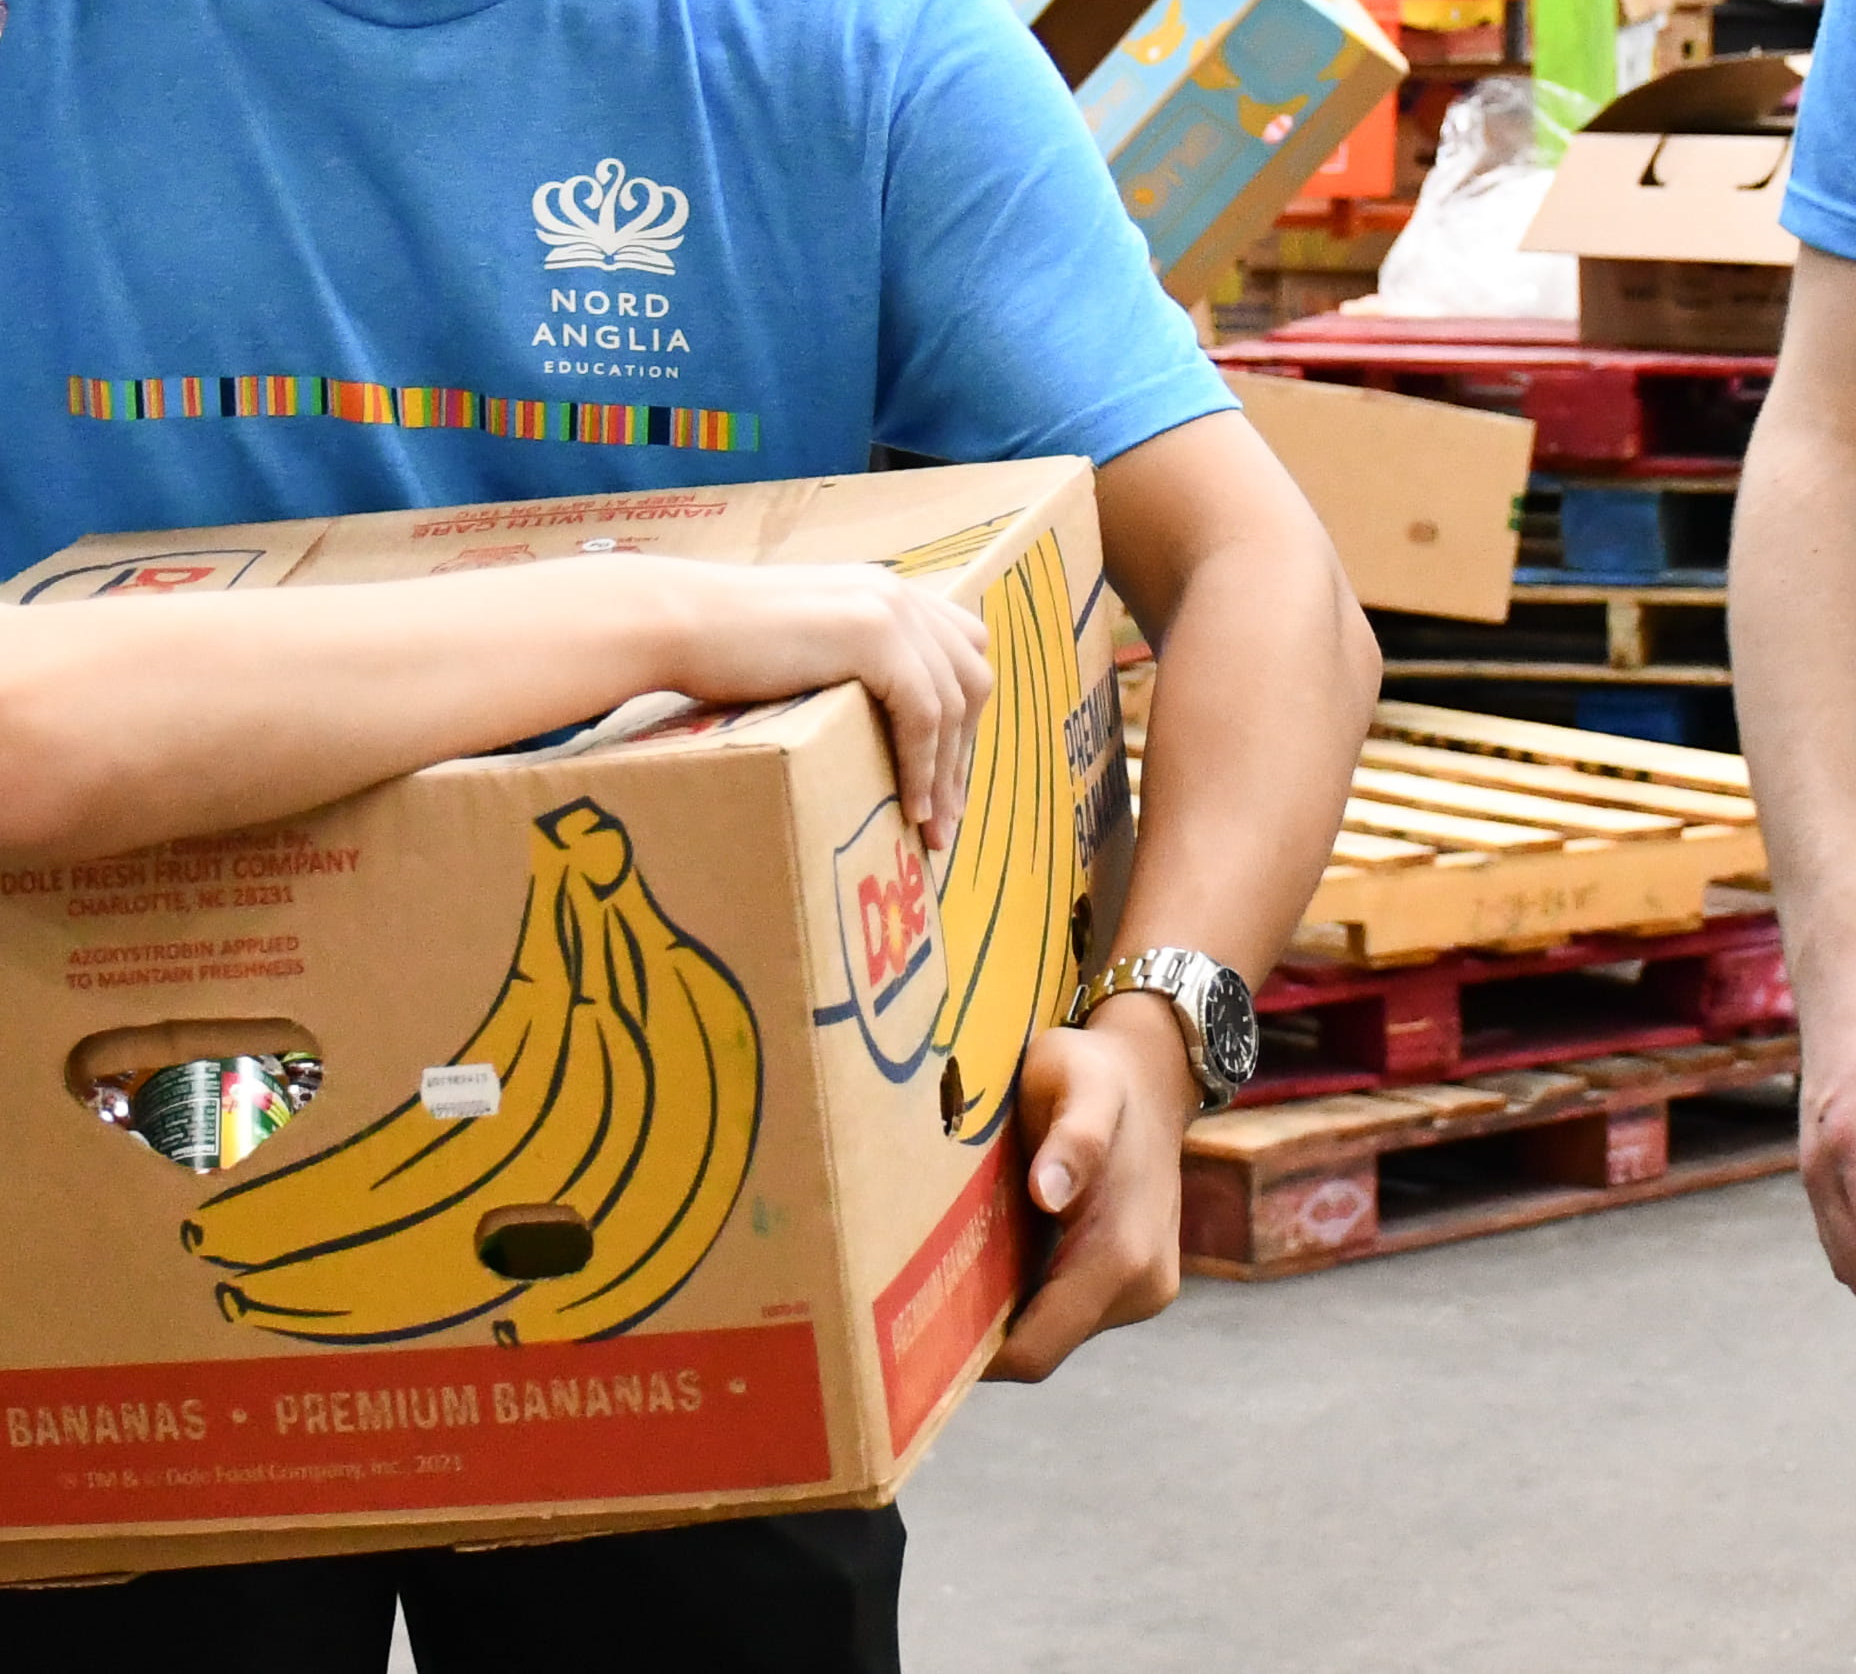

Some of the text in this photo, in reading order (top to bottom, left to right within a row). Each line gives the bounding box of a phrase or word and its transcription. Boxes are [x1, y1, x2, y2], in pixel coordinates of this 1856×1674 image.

[551, 289, 670, 318] NORD
[531, 323, 690, 353] ANGLIA
[543, 361, 679, 379] EDUCATION
[411, 504, 726, 539] HANDLE WITH CARE
[1, 849, 360, 896] DOLE FRESH FRUIT COMPANY
[198, 890, 226, 909] NC
[857, 838, 926, 988] Dole
[221, 935, 300, 956] APPLIED
[66, 957, 305, 990] TO MAINTAIN FRESHNESS
[273, 1369, 704, 1437] PREMIUM BANANAS
[6, 1398, 207, 1449] BANANAS
